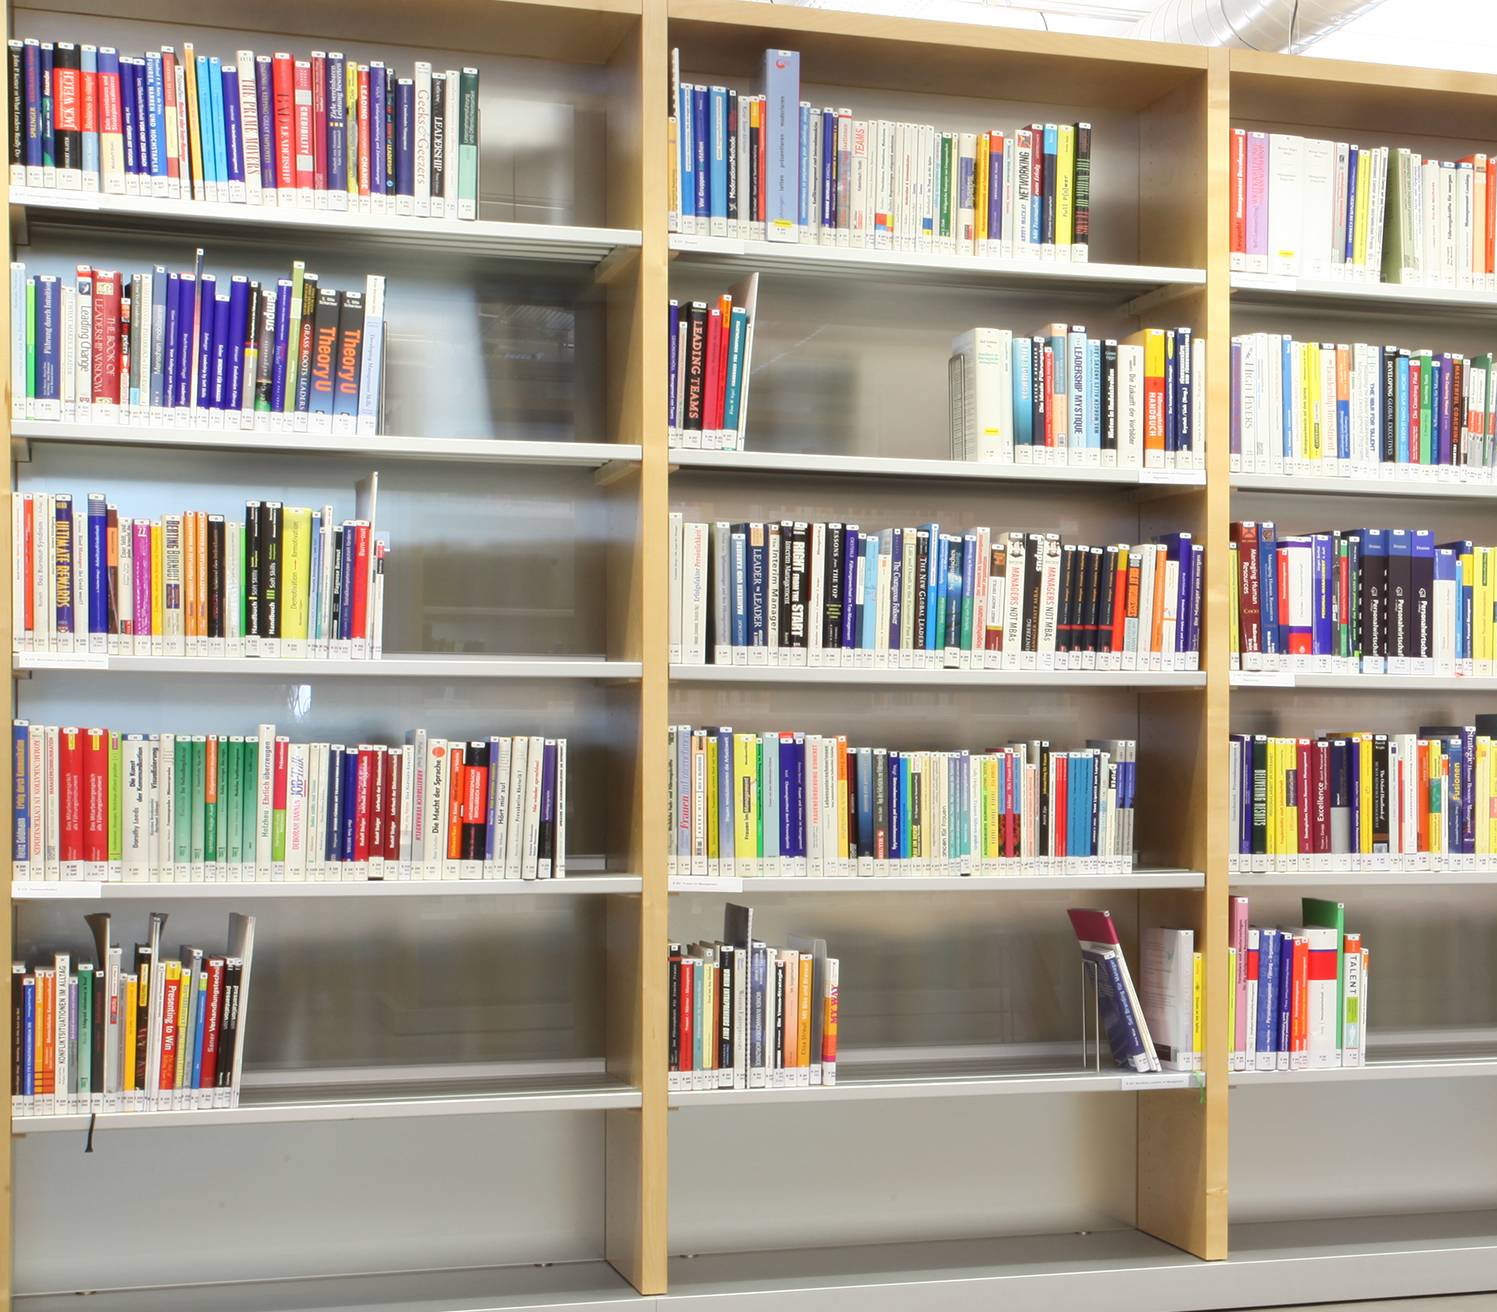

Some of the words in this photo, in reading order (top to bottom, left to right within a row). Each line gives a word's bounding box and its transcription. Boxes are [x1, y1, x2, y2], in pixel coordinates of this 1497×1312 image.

[63, 71, 75, 104] WELCH
[241, 79, 255, 97] THE
[360, 85, 368, 120] LEADING
[63, 106, 78, 129] JACK
[243, 101, 257, 133] PRIME
[336, 93, 344, 119] Leistung
[417, 89, 429, 125] Geeks
[300, 106, 309, 154] CREDIBILITY
[434, 116, 443, 171] LEADERSHIP
[854, 128, 864, 155] TEAMS
[245, 135, 260, 175] MOVERS
[280, 126, 290, 184] LEADERSHIP
[416, 138, 428, 185] Geezers
[1033, 164, 1041, 182] Erfolg
[79, 306, 91, 339] Leading
[95, 298, 104, 350] LEADERSHIP
[106, 317, 115, 332] THE
[154, 305, 163, 340] mobilisieren
[303, 324, 311, 348] GRASS
[44, 329, 52, 354] Führung
[78, 341, 91, 372] Change
[106, 336, 115, 361] BOOK
[313, 327, 336, 379] Theory
[338, 330, 361, 382] Theory
[691, 320, 703, 375] LEADING
[95, 354, 103, 392] WISDOM
[108, 363, 115, 376] OF
[154, 342, 162, 375] Menschen
[301, 350, 309, 375] ROOTS
[1073, 347, 1084, 392] LEADERSHIP
[299, 378, 307, 410] LEADERS
[315, 380, 332, 392] U
[341, 383, 358, 394] U
[1128, 373, 1136, 383] Die
[689, 378, 701, 419] TEAMS
[1128, 384, 1136, 406] Zukunft
[1074, 395, 1083, 435] MYSTIQUE
[1107, 418, 1115, 438] Nieten
[1128, 408, 1136, 418] der
[1148, 392, 1157, 437] HANDBUCH
[56, 521, 70, 563] ULTIMATE
[166, 520, 179, 549] BEATING
[167, 549, 179, 582] BURNOUT
[752, 549, 761, 585] LEADER
[771, 549, 779, 586] Interim
[792, 541, 805, 573] RIGHT
[1249, 548, 1257, 580] Managing
[56, 565, 69, 608] REWARDS
[783, 566, 791, 604] Management
[1010, 567, 1019, 606] MANAGERS
[1046, 567, 1056, 605] MANAGERS
[753, 593, 761, 628] LEADER
[770, 588, 778, 632] Manager
[791, 604, 803, 637] START
[1009, 607, 1018, 622] NOT
[1045, 606, 1054, 621] NOT
[1008, 622, 1017, 642] MBAs
[1043, 622, 1053, 641] MBAs
[263, 741, 271, 780] überzeugen
[434, 760, 442, 785] Sprache
[262, 781, 270, 805] Ehrlich
[433, 787, 441, 798] der
[1254, 770, 1266, 801] DELIVERING
[432, 800, 440, 821] Macht
[1254, 803, 1266, 826] RESULTS
[1317, 782, 1325, 822] Excellence
[132, 826, 140, 848] Dorothy
[58, 965, 66, 987] ALLTAG
[1348, 954, 1358, 995] TALENT
[165, 985, 177, 1024] Presenting
[57, 997, 67, 1064] KONFLIKTSITUATIONEN
[164, 1035, 174, 1051] Win
